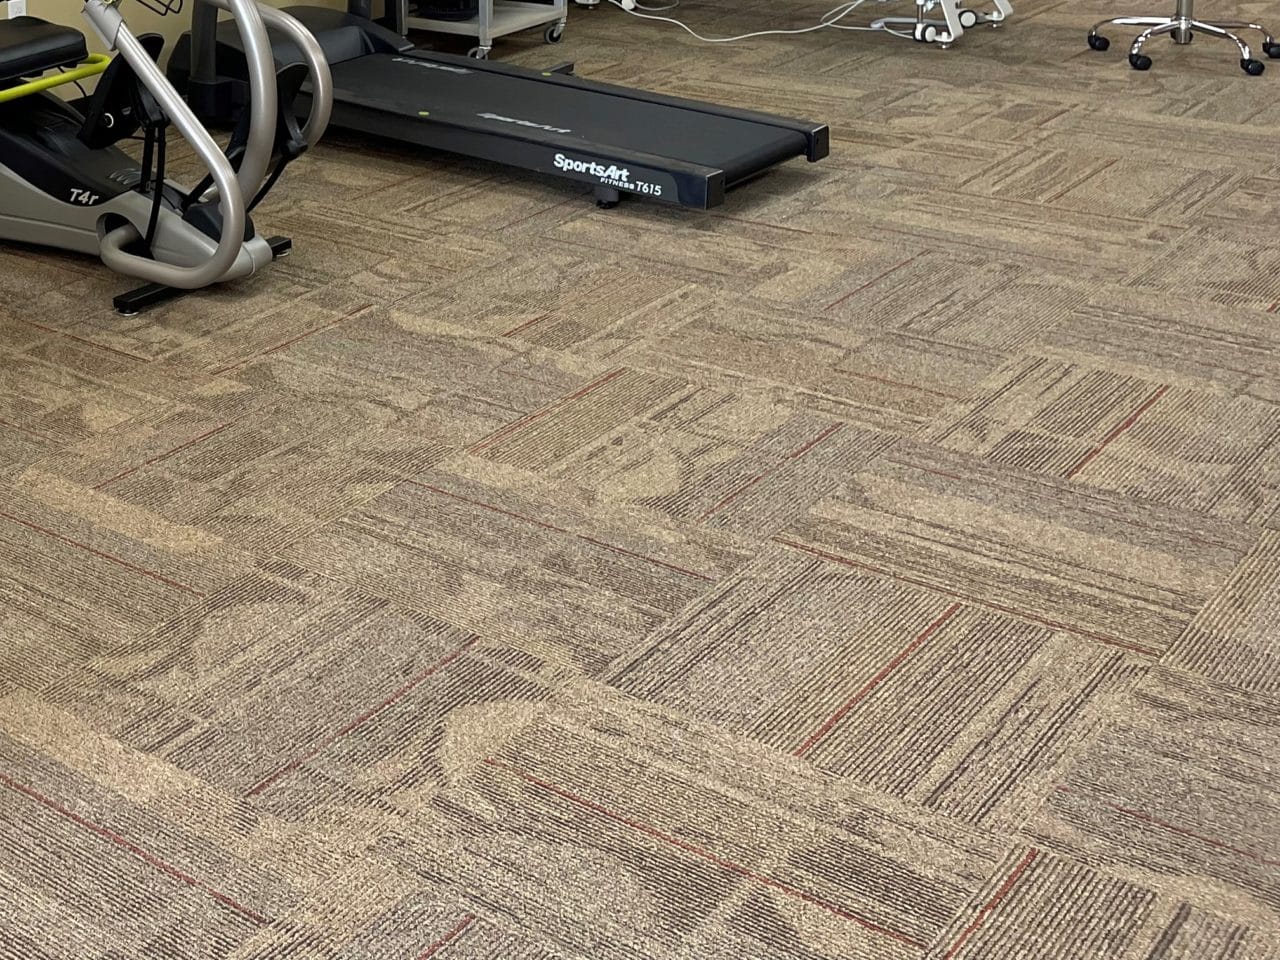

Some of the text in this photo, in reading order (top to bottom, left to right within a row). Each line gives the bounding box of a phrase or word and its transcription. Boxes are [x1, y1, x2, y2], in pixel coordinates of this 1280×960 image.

[553, 153, 630, 182] SportsArt
[600, 177, 662, 196] FITNESS T615
[70, 188, 99, 205] T4r
